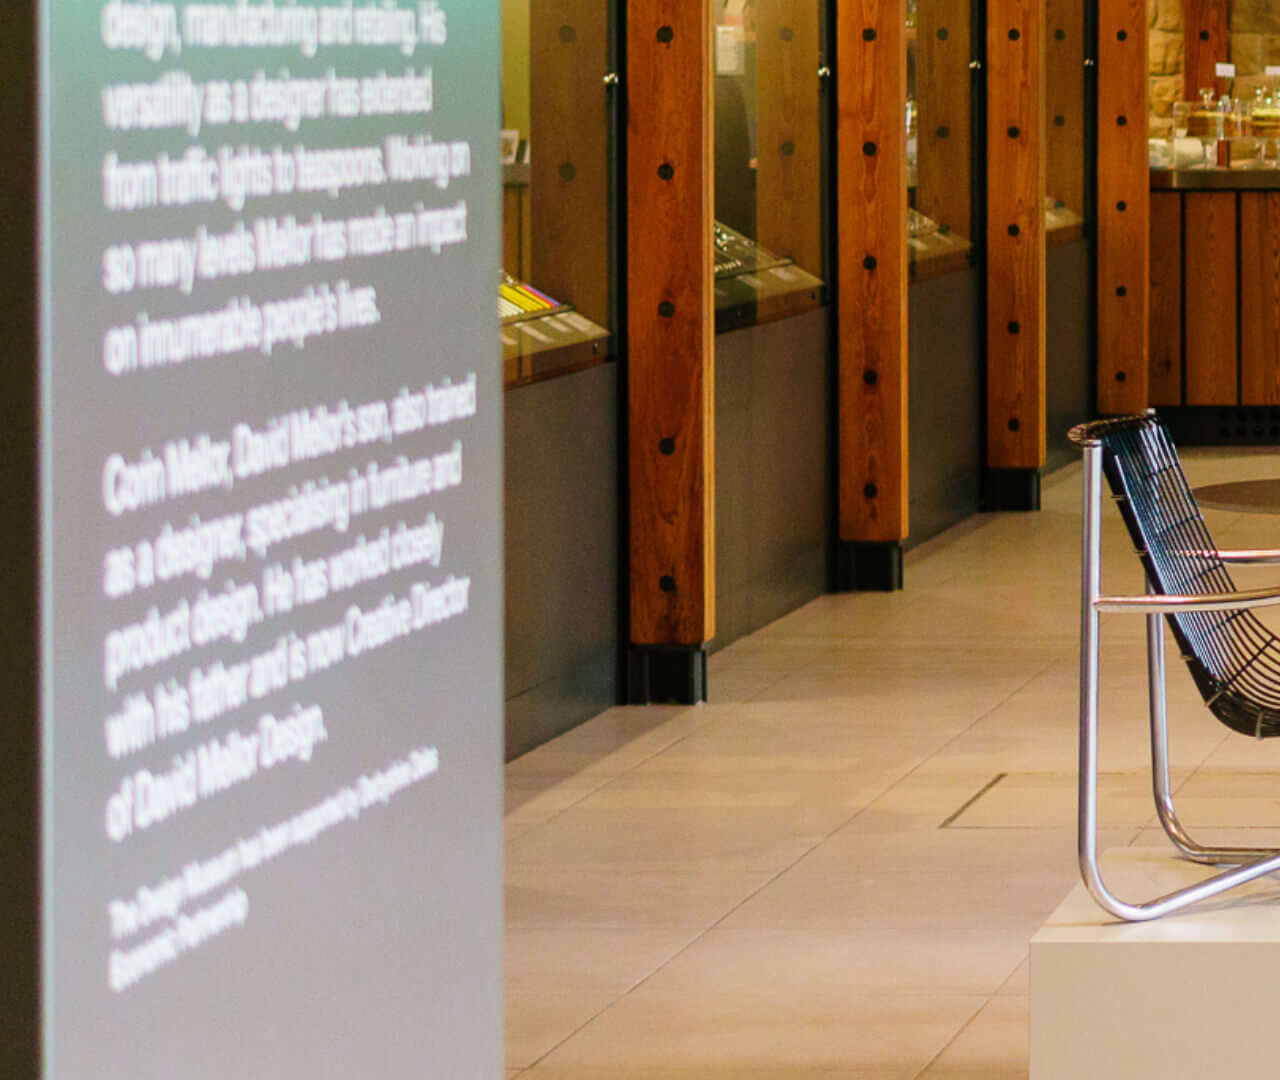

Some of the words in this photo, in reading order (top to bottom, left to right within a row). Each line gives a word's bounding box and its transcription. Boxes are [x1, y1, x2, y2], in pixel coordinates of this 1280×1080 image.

[319, 0, 353, 45] and
[420, 0, 447, 45] His
[101, 69, 203, 136] versatility
[205, 82, 233, 123] as
[234, 82, 247, 121] a
[251, 68, 324, 130] designer
[326, 68, 361, 115] has
[362, 66, 433, 113] extended
[103, 151, 157, 210] from
[159, 147, 218, 204] traffic
[219, 145, 272, 211] lights
[274, 147, 295, 193] to
[386, 135, 448, 189] Working
[450, 139, 470, 176] on
[103, 244, 135, 292] so
[138, 239, 197, 295] many
[198, 223, 255, 278] levels
[257, 214, 312, 269] Mellor
[314, 212, 346, 261] has
[348, 205, 392, 256] made
[394, 211, 415, 250] an
[417, 200, 468, 254] impact
[103, 327, 136, 375] on
[139, 295, 260, 366] innumerable
[102, 450, 165, 515] Corin
[165, 433, 234, 498] Mellor,
[233, 417, 289, 479] David
[391, 388, 426, 436] also
[427, 373, 477, 423] trained
[104, 546, 135, 598] as
[136, 539, 154, 586] a
[351, 470, 368, 514] in
[369, 454, 431, 507] furniture
[432, 440, 462, 489] and
[105, 599, 190, 691] product
[192, 581, 263, 645] design.
[263, 566, 293, 617] He
[295, 558, 328, 606] has
[329, 528, 390, 591] worked
[392, 513, 444, 569] closely
[106, 695, 155, 760] with
[155, 679, 190, 738] his
[191, 663, 251, 722] father
[251, 636, 288, 698] and
[290, 633, 307, 679] is
[308, 624, 344, 673] now
[346, 594, 411, 657] Creative
[412, 575, 470, 630] Director
[106, 775, 133, 841] of
[134, 752, 196, 830] David
[197, 729, 259, 798] Mellor
[260, 701, 328, 769] Design.
